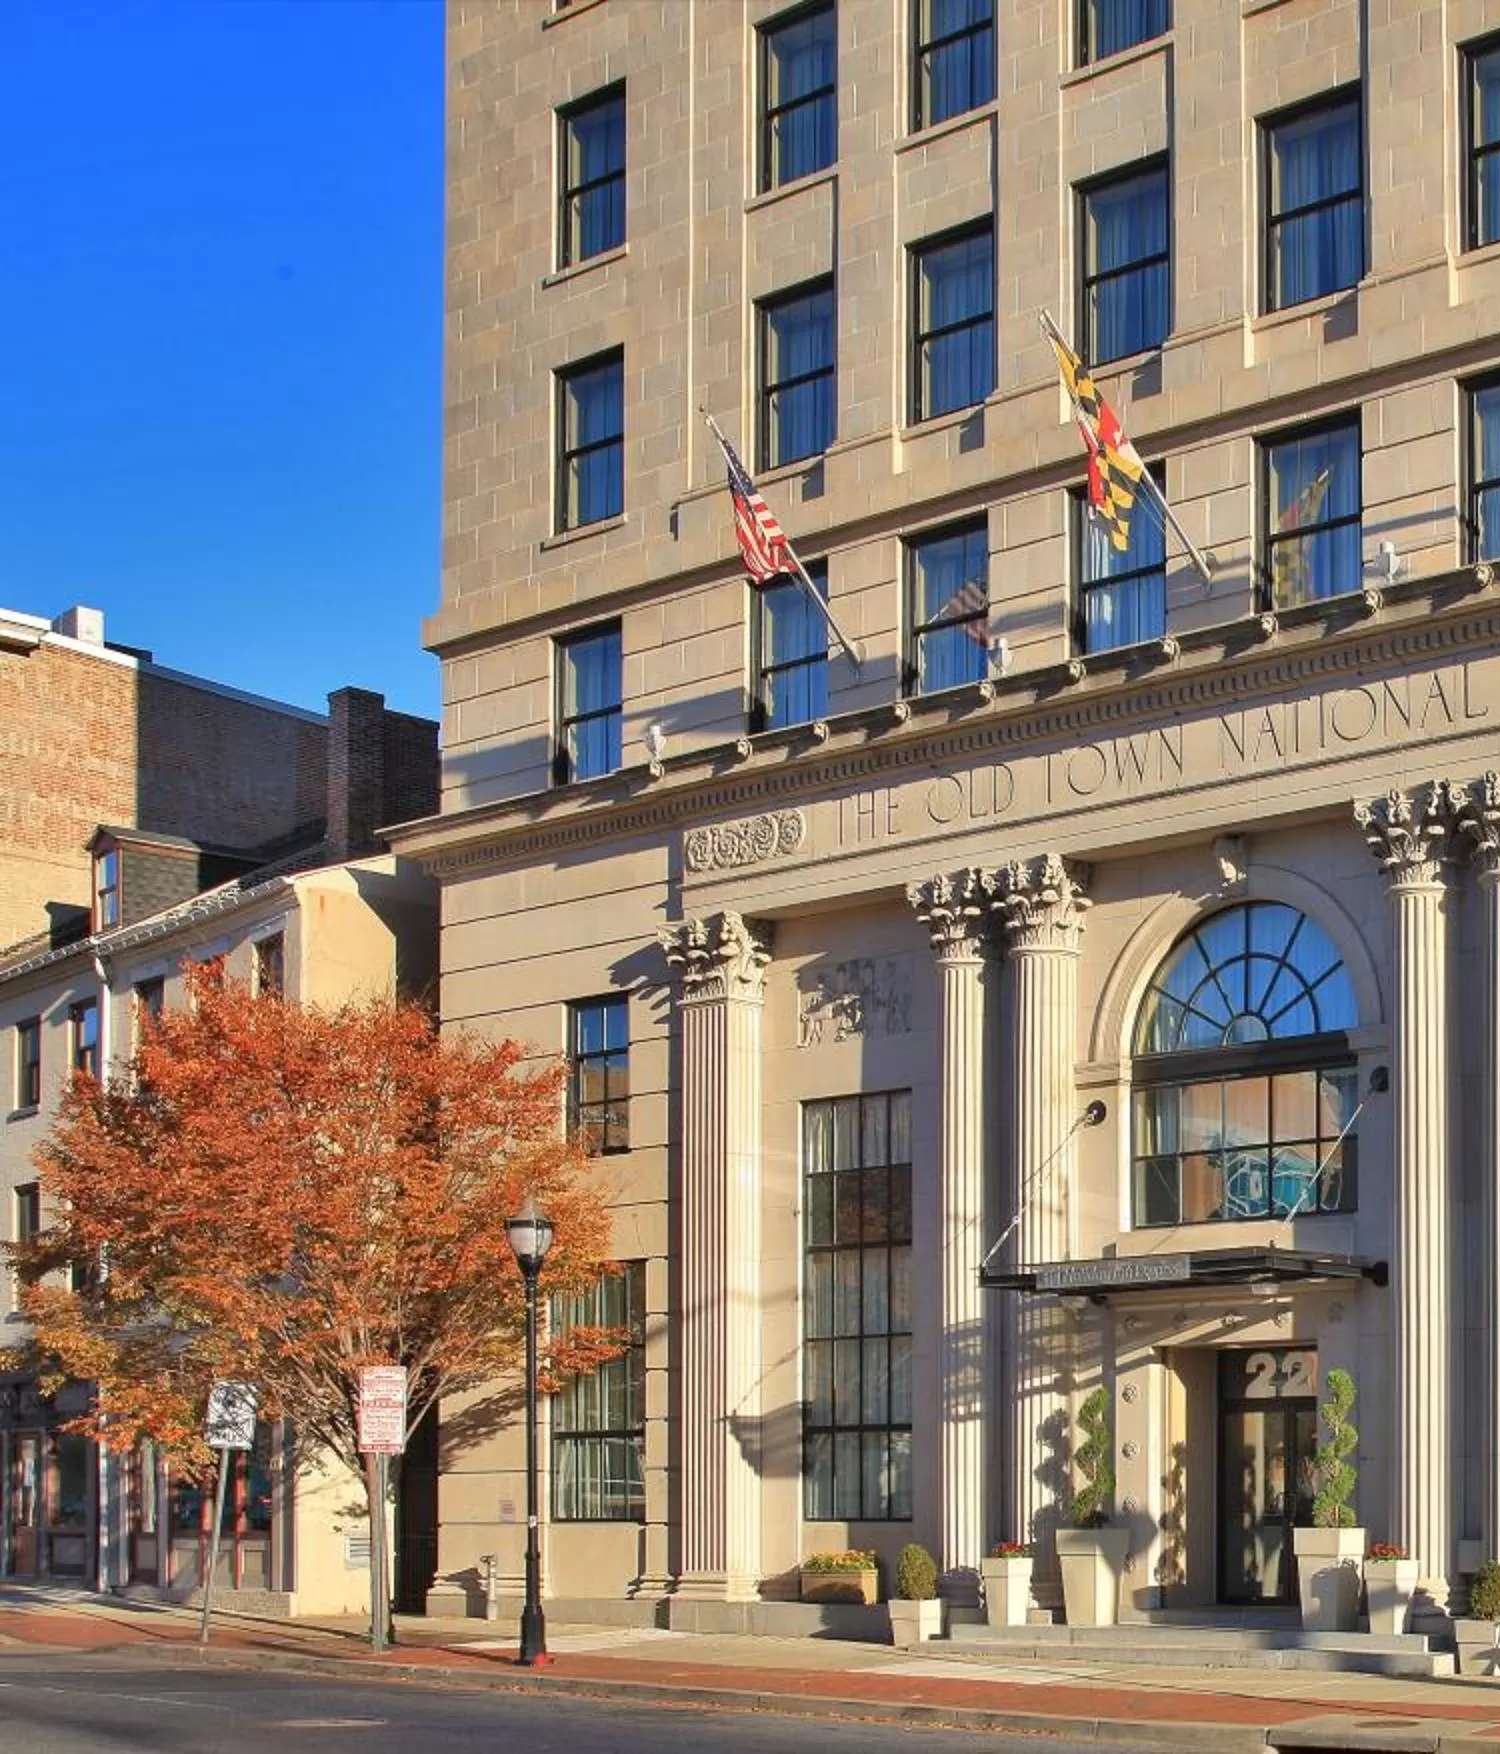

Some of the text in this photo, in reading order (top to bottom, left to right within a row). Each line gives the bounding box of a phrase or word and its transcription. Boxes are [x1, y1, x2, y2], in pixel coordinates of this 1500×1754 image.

[835, 785, 901, 846] THE
[926, 763, 1014, 823] OLD
[1038, 722, 1184, 804] TOWN
[1219, 662, 1489, 768] NATIONAL
